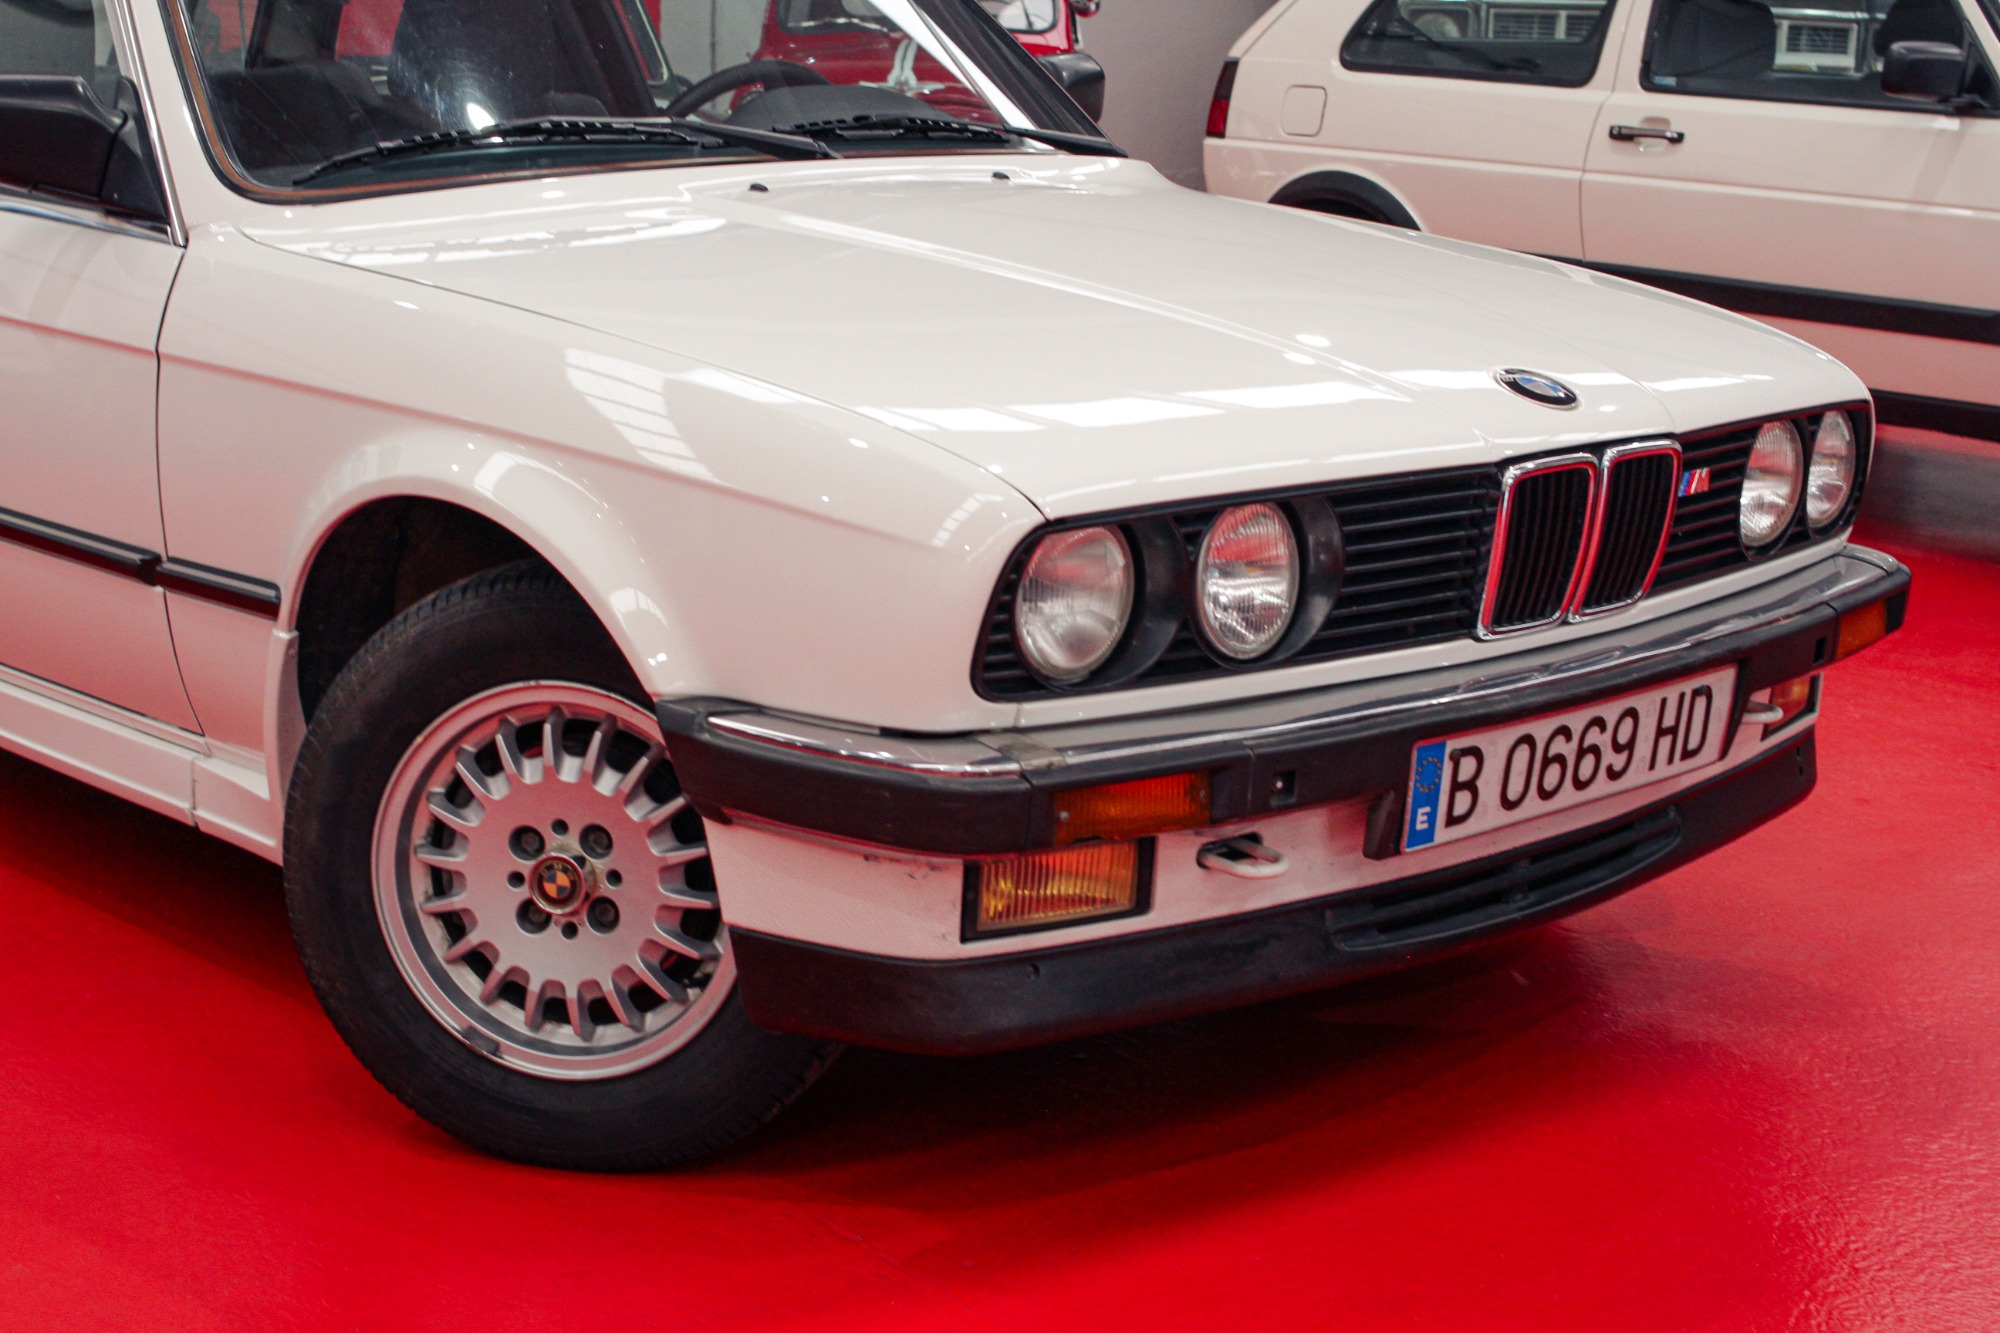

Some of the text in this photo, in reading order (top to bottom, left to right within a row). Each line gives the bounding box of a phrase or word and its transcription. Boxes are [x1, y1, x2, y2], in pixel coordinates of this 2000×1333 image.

[1445, 684, 1713, 829] B 0669 HD
[1415, 806, 1431, 831] E
